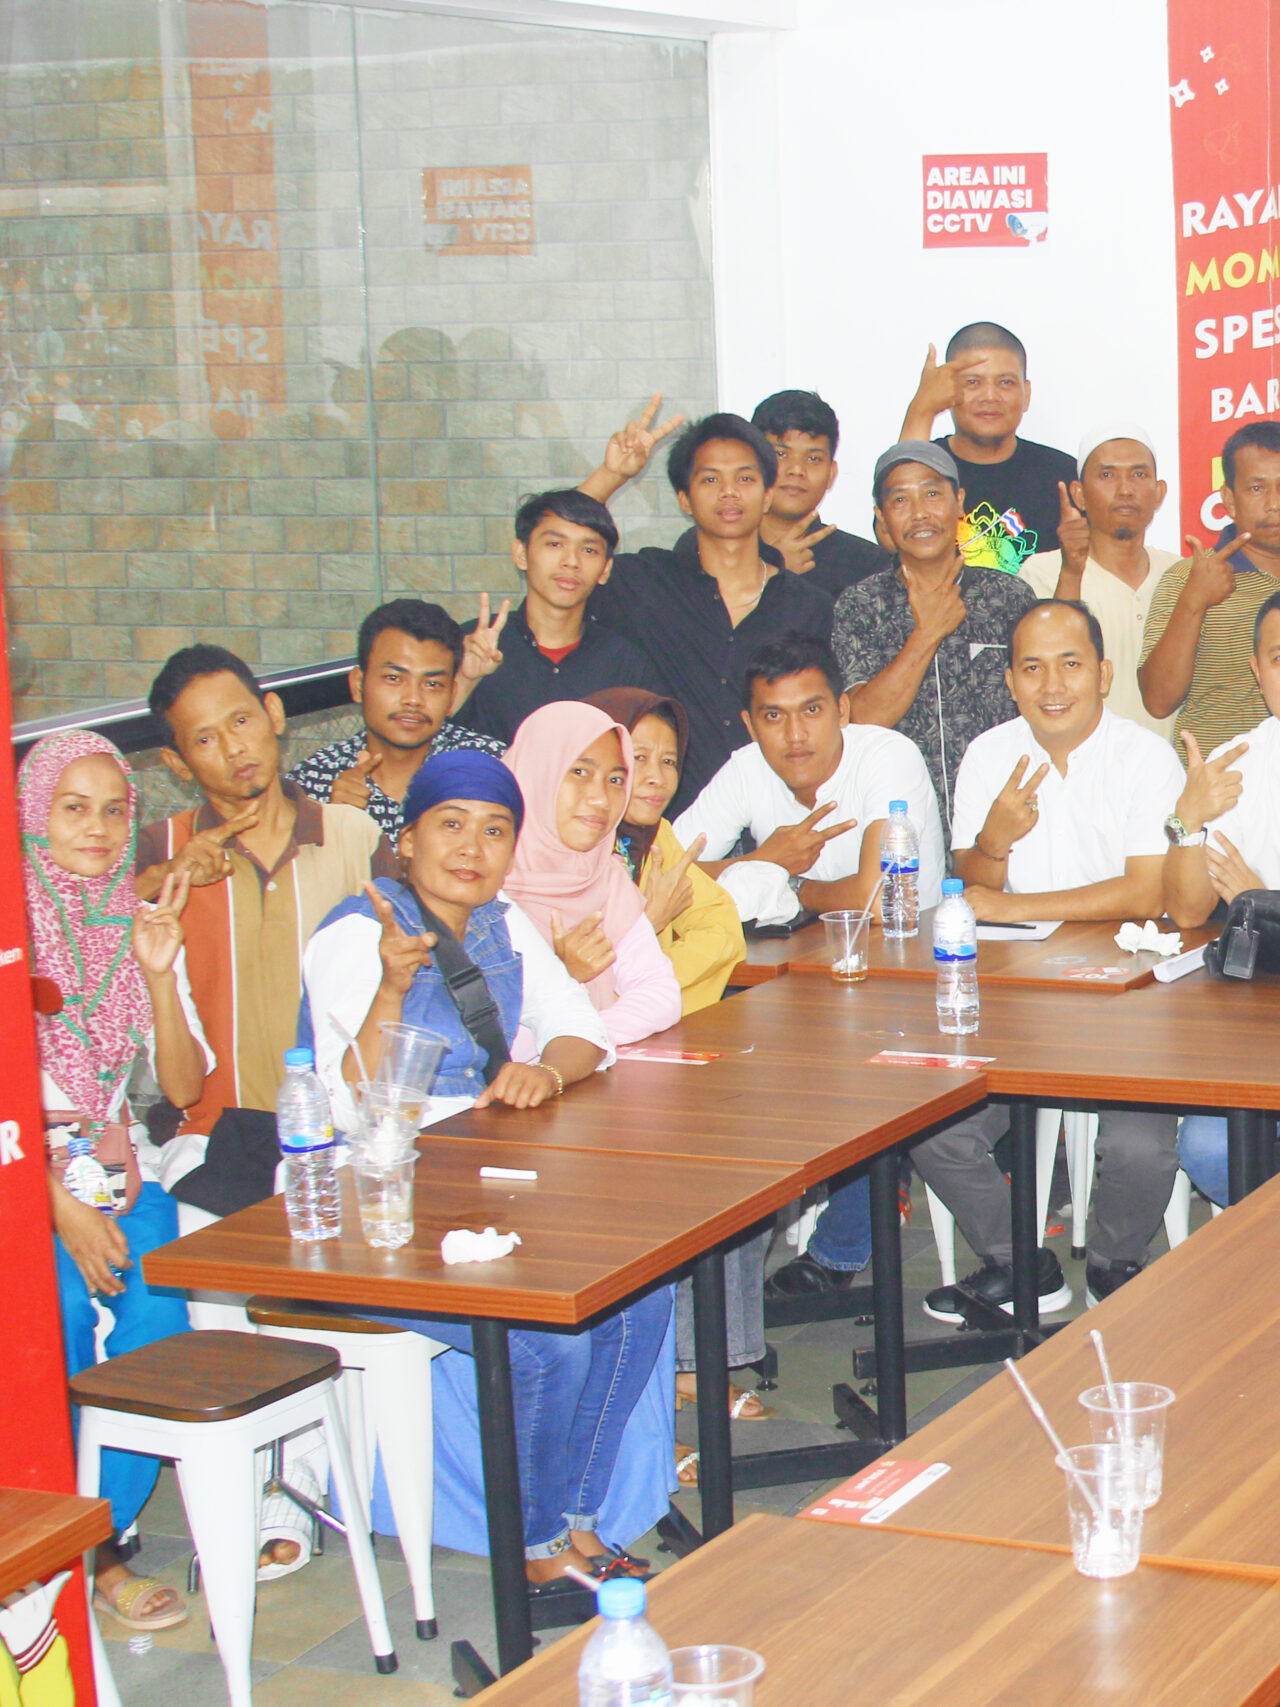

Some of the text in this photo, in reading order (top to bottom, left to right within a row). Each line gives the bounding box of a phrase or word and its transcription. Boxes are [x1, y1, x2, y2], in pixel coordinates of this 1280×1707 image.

[926, 165, 1026, 186] AREA INI
[927, 188, 1033, 210] DIAWASI
[926, 212, 993, 233] CCTV
